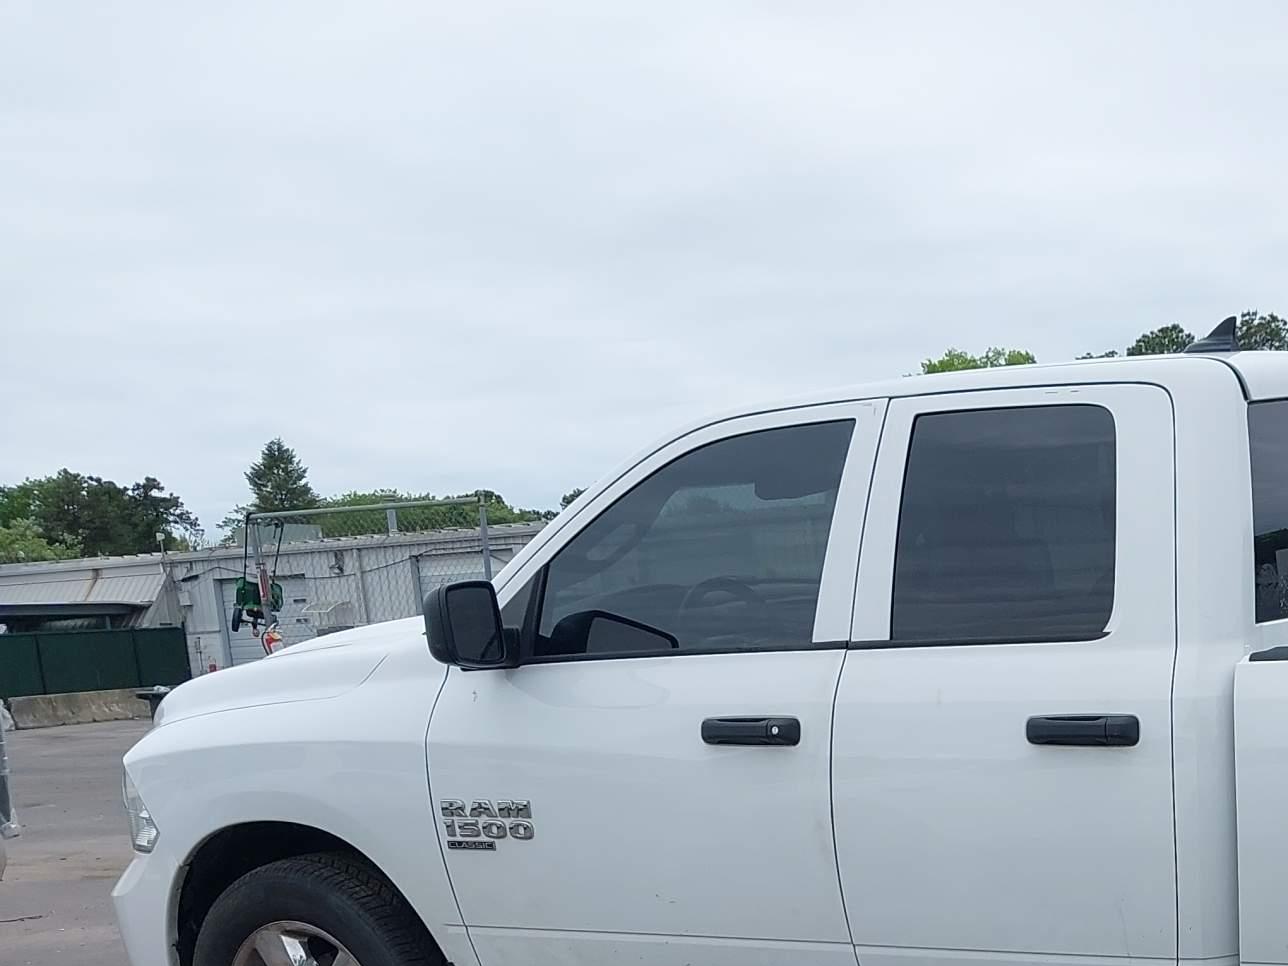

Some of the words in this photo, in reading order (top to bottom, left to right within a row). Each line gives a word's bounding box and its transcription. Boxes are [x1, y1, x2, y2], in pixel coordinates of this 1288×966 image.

[440, 799, 532, 819] RAM
[443, 819, 535, 840] 1500
[448, 841, 495, 850] CLASSIC
